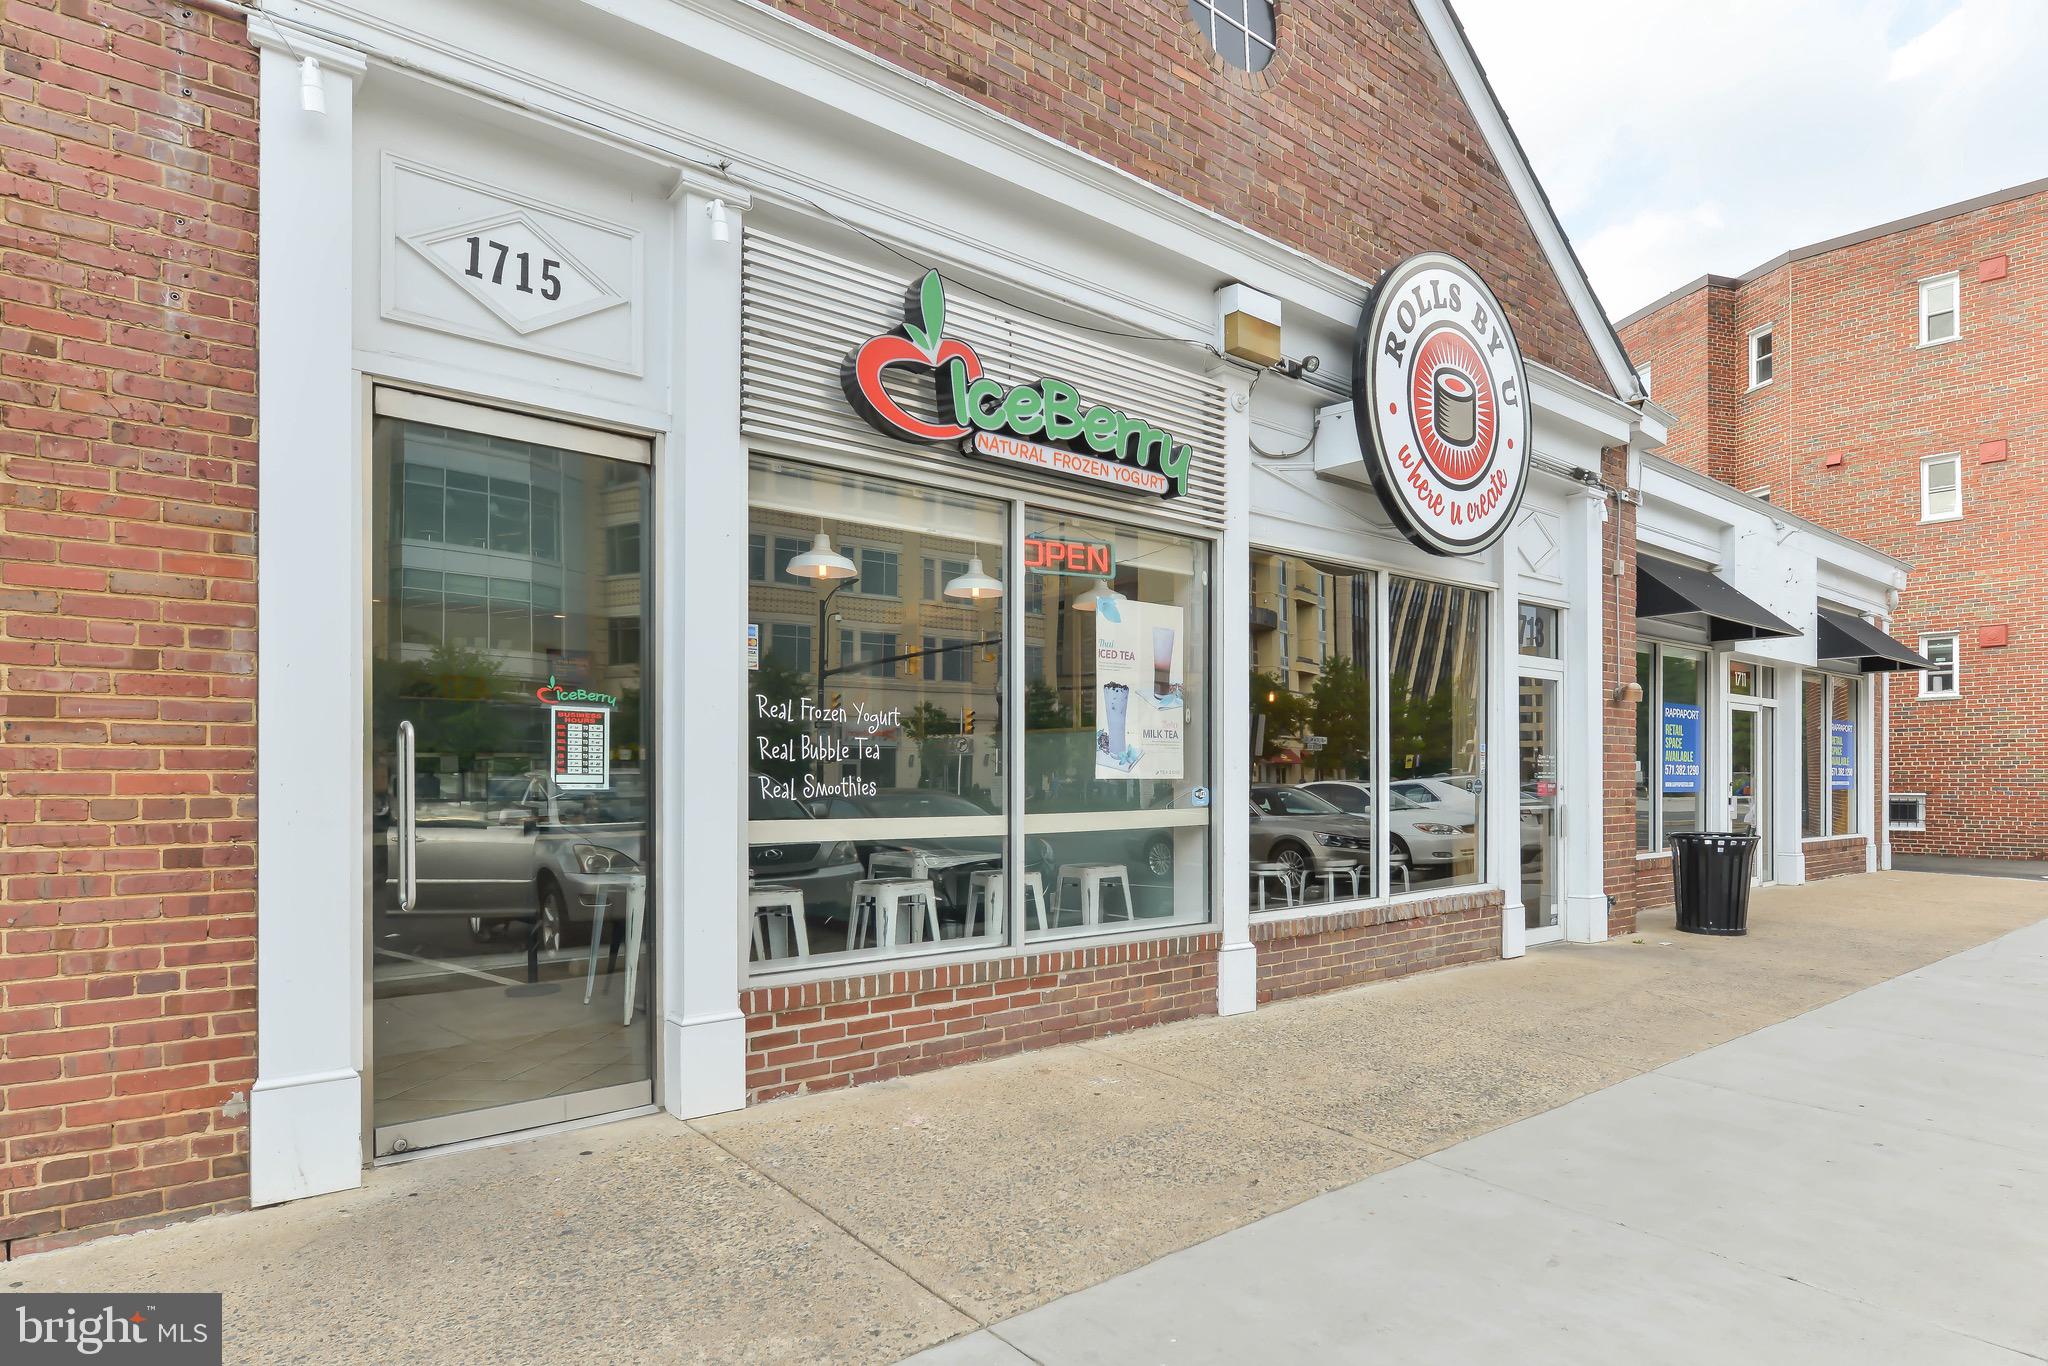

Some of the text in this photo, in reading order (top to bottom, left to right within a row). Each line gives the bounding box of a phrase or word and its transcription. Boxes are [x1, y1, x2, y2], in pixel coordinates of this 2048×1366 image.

[464, 236, 561, 301] 1715
[1384, 279, 1519, 408] ROLLS BY U
[951, 358, 1193, 497] IceBerry
[977, 433, 1166, 491] NATURAL FROZEN YOGURT
[1397, 442, 1445, 517] where
[1466, 467, 1508, 523] create
[1024, 538, 1109, 573] OPEN
[1098, 648, 1136, 661] ICED TEA
[1734, 671, 1747, 687] 1711
[556, 688, 617, 707] IceBerry
[557, 711, 603, 719] BUSINESS
[755, 694, 901, 734] Real Frozen Yogurt
[1664, 707, 1700, 720] RAPPAPORT
[1142, 729, 1179, 739] MILK TEA
[1665, 723, 1684, 736] RETAIL
[756, 734, 880, 762] Real Bubble Tea
[1664, 737, 1683, 749] SPACE
[1664, 750, 1694, 763] AVAILABLE
[758, 773, 877, 801] Real Smoothies
